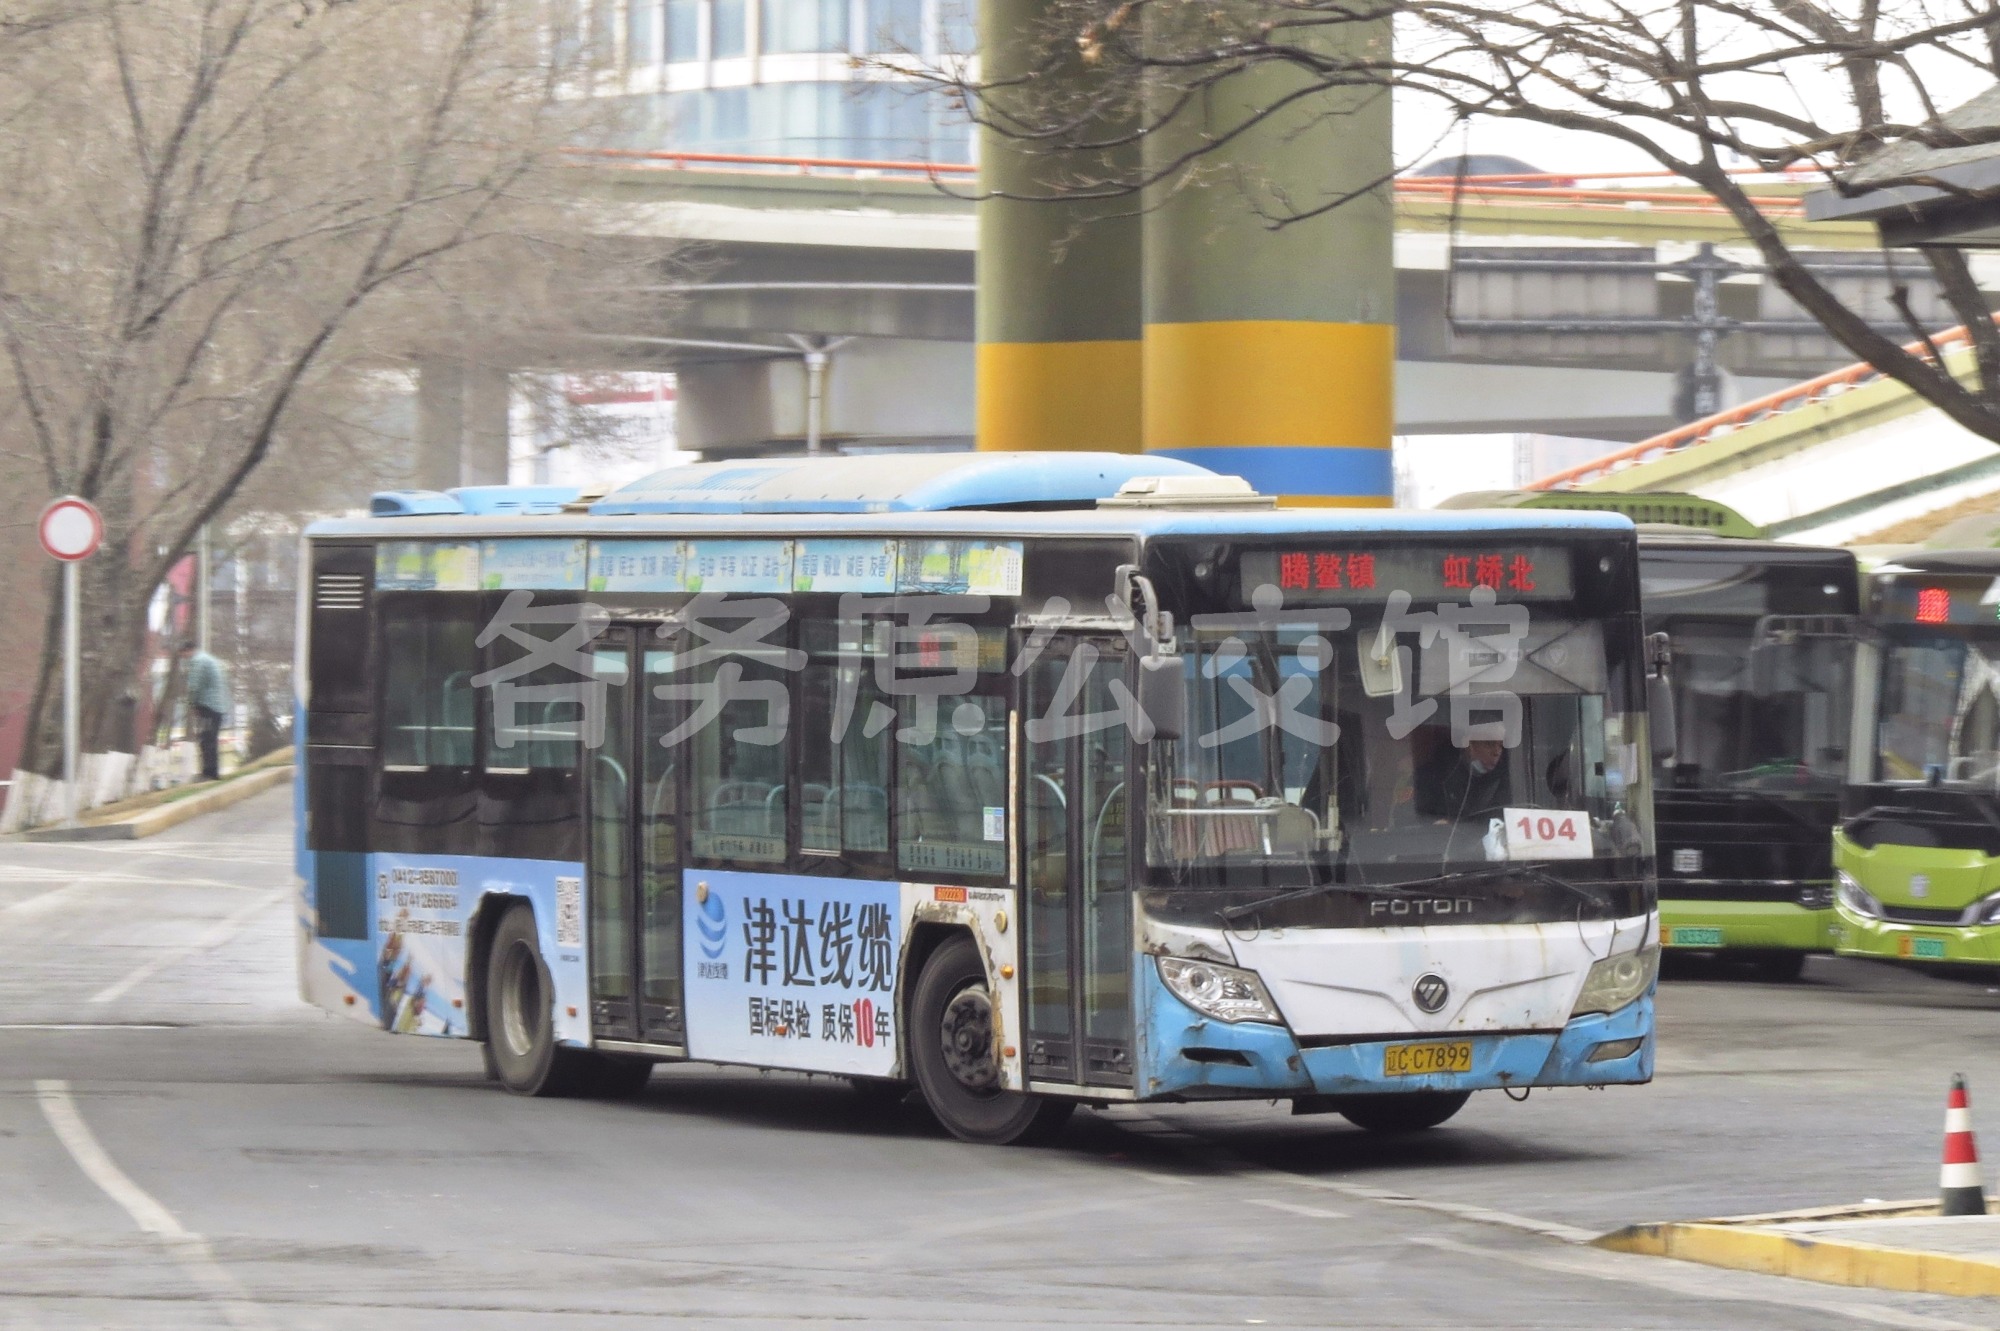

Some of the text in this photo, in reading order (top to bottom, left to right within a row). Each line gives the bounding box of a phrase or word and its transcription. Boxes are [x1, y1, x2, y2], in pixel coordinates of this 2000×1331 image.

[1280, 553, 1536, 591] 腾鳌镇 虹桥北
[1517, 817, 1577, 841] 104
[1370, 899, 1473, 916] FOTON
[743, 897, 894, 991] 津达线缆
[748, 996, 891, 1048] 国标保检 质保10年
